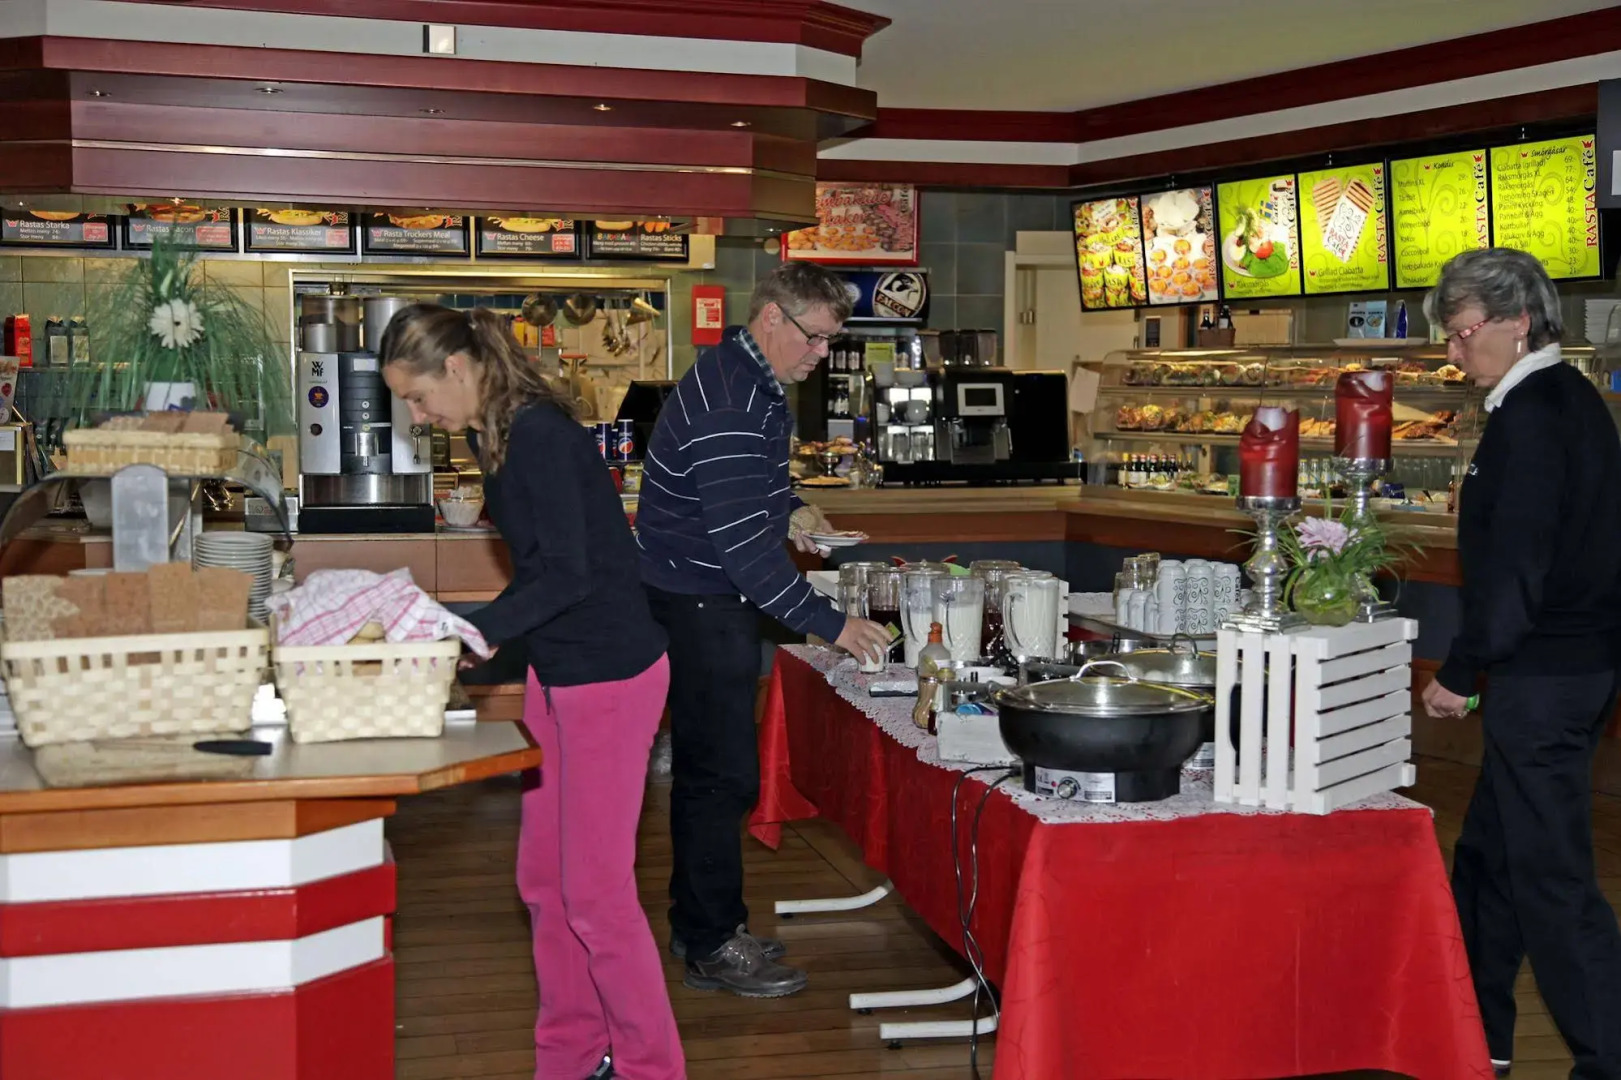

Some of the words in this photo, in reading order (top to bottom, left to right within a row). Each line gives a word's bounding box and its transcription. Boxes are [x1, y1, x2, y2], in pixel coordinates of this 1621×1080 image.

[1497, 162, 1521, 172] Ciabatta
[1582, 149, 1595, 192] Café
[1374, 176, 1383, 213] Café
[1474, 163, 1485, 203] Café
[1287, 187, 1295, 223] Café
[20, 220, 45, 228] Rastas
[45, 221, 70, 229] Starka
[147, 224, 170, 233] Rastas
[1585, 192, 1597, 248] RASTA
[267, 228, 290, 236] Rastas
[291, 228, 322, 236] Klassiker
[384, 230, 402, 238] Rasta
[404, 230, 432, 238] Truckers
[519, 233, 544, 241] Cheese
[640, 233, 662, 241] Rastas
[663, 234, 682, 242] Sticks
[1376, 214, 1386, 263] RASTA
[1287, 225, 1298, 270] RASTA
[876, 294, 912, 317] FALCON
